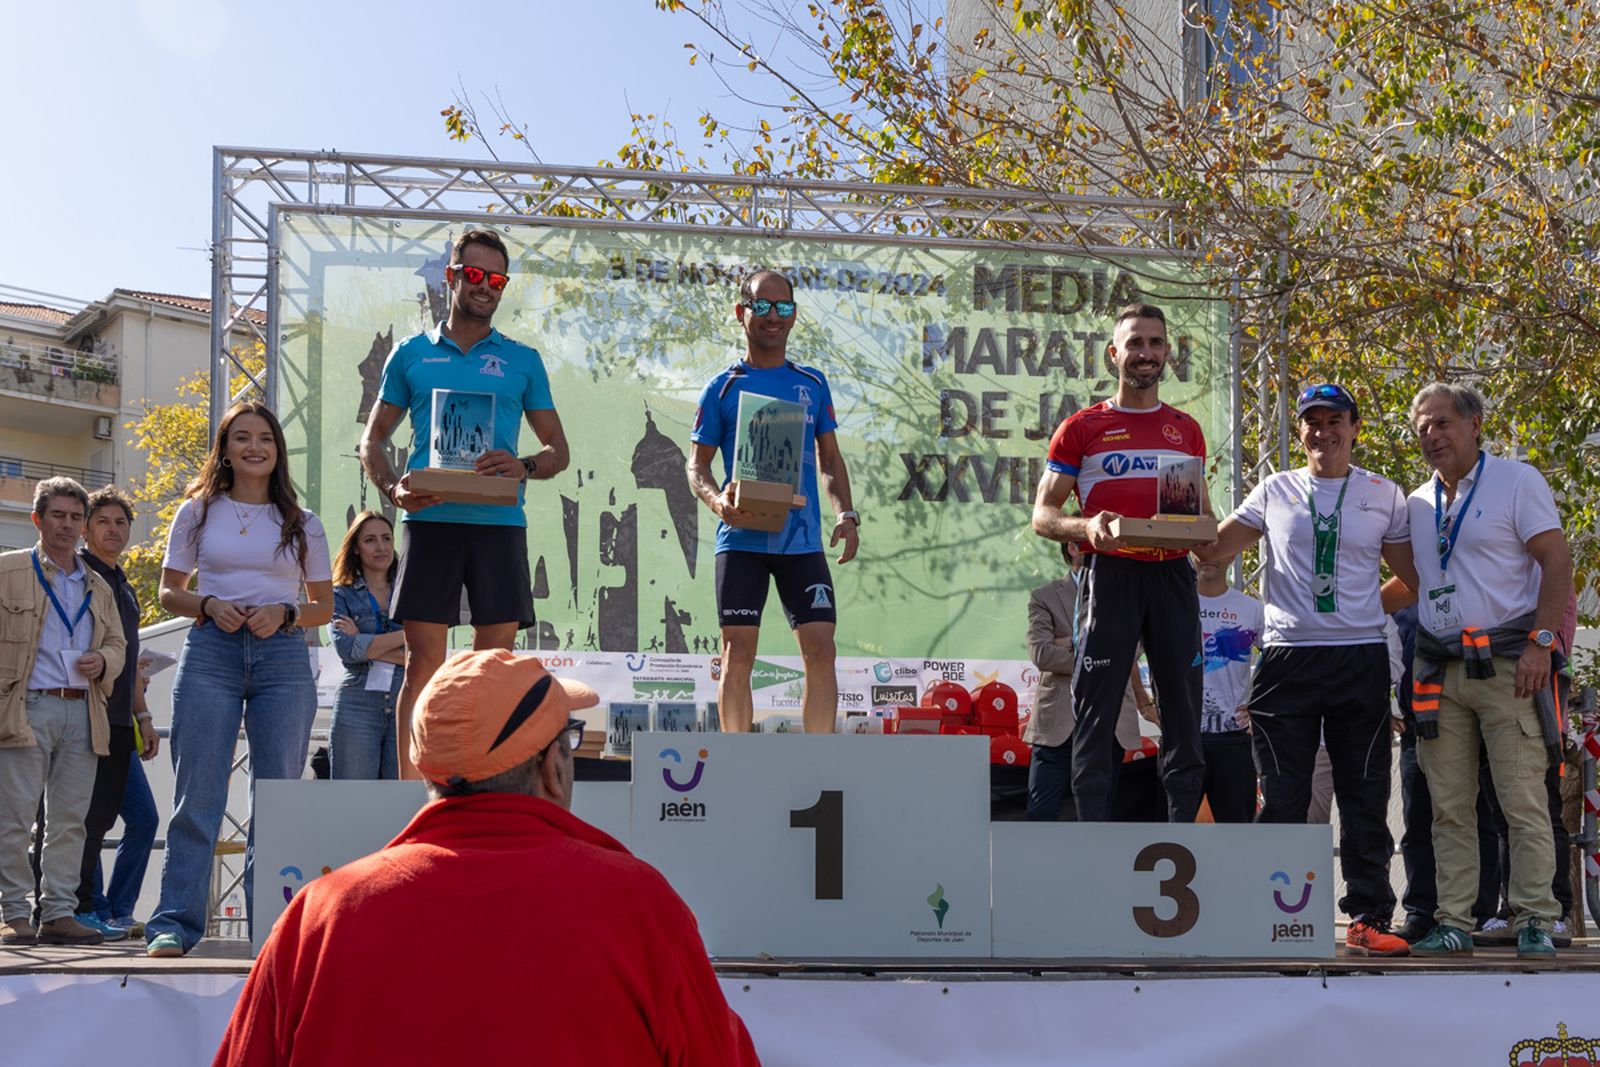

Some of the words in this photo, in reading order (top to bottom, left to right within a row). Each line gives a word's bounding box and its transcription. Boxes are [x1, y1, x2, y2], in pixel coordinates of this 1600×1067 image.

[635, 258, 671, 283] DE
[837, 269, 870, 293] DE
[877, 271, 947, 297] 2024
[973, 264, 1139, 316] MEDIA
[939, 389, 1009, 440] DE
[894, 667, 918, 675] clibo
[923, 660, 965, 672] POWER
[942, 672, 966, 681] ADE
[873, 687, 914, 703] Luisitas
[790, 790, 843, 900] 1
[1132, 842, 1200, 938] 3
